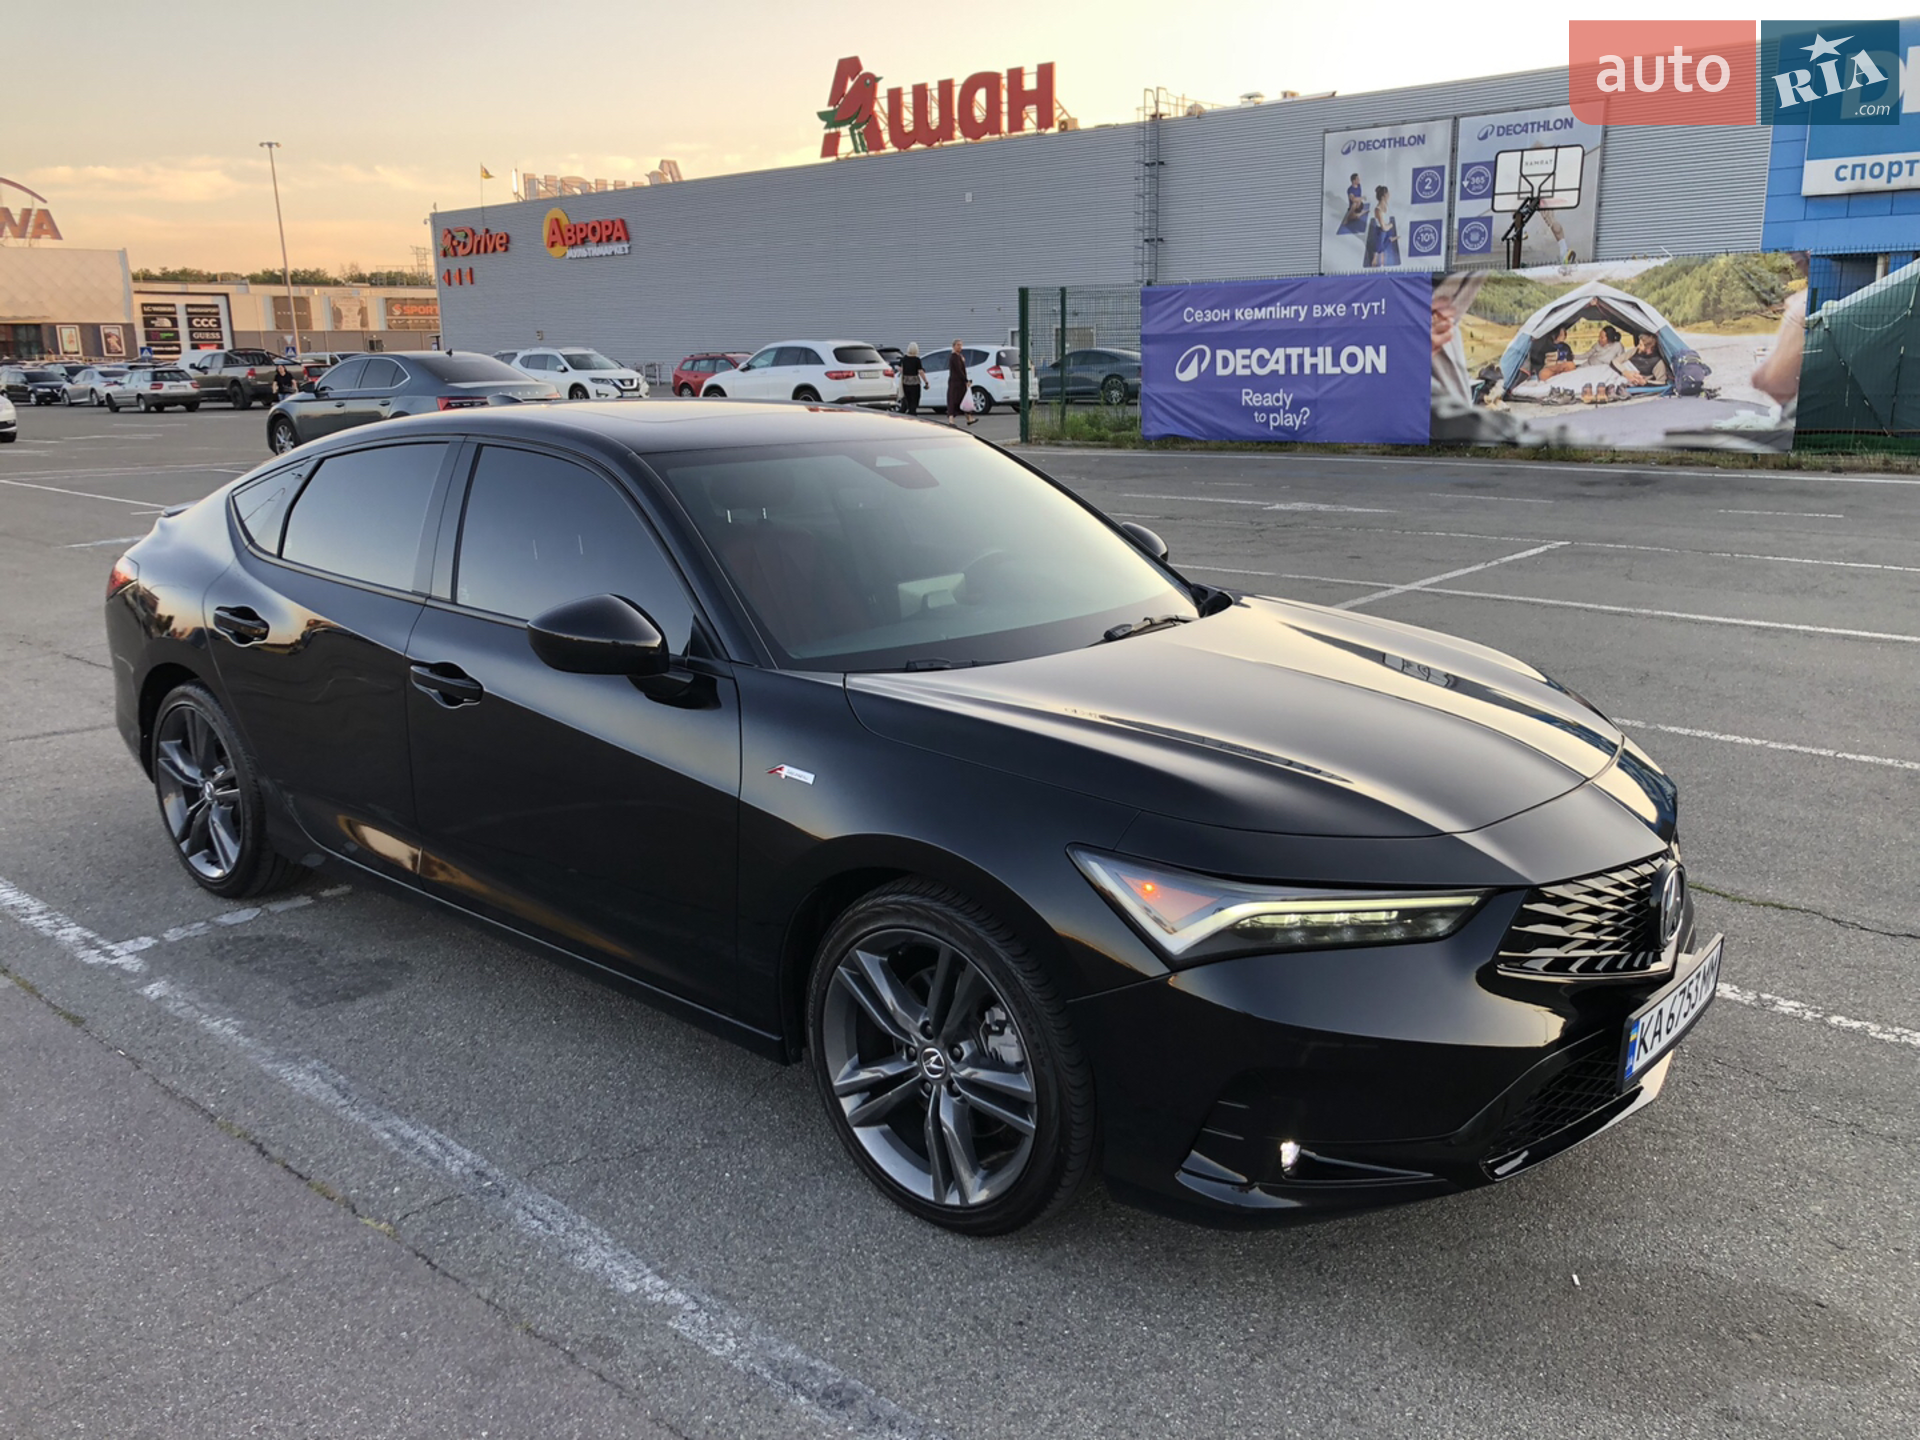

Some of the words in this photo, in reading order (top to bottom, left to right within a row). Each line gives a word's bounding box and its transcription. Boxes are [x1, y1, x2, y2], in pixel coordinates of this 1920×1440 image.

[820, 55, 1056, 158] Ашан
[1496, 117, 1575, 137] DECATHLON
[1357, 134, 1426, 152] DECATHLON
[1424, 177, 1432, 190] 2
[1183, 306, 1231, 323] Сезон
[1234, 302, 1308, 322] кемпінгу
[1312, 301, 1347, 318] вже
[1351, 298, 1387, 319] тут!
[192, 318, 218, 328] CCC
[192, 332, 221, 340] GUESS
[1215, 344, 1388, 376] DECATHLON
[1241, 388, 1293, 410] Ready
[1253, 411, 1267, 424] to
[1269, 407, 1311, 431] play?
